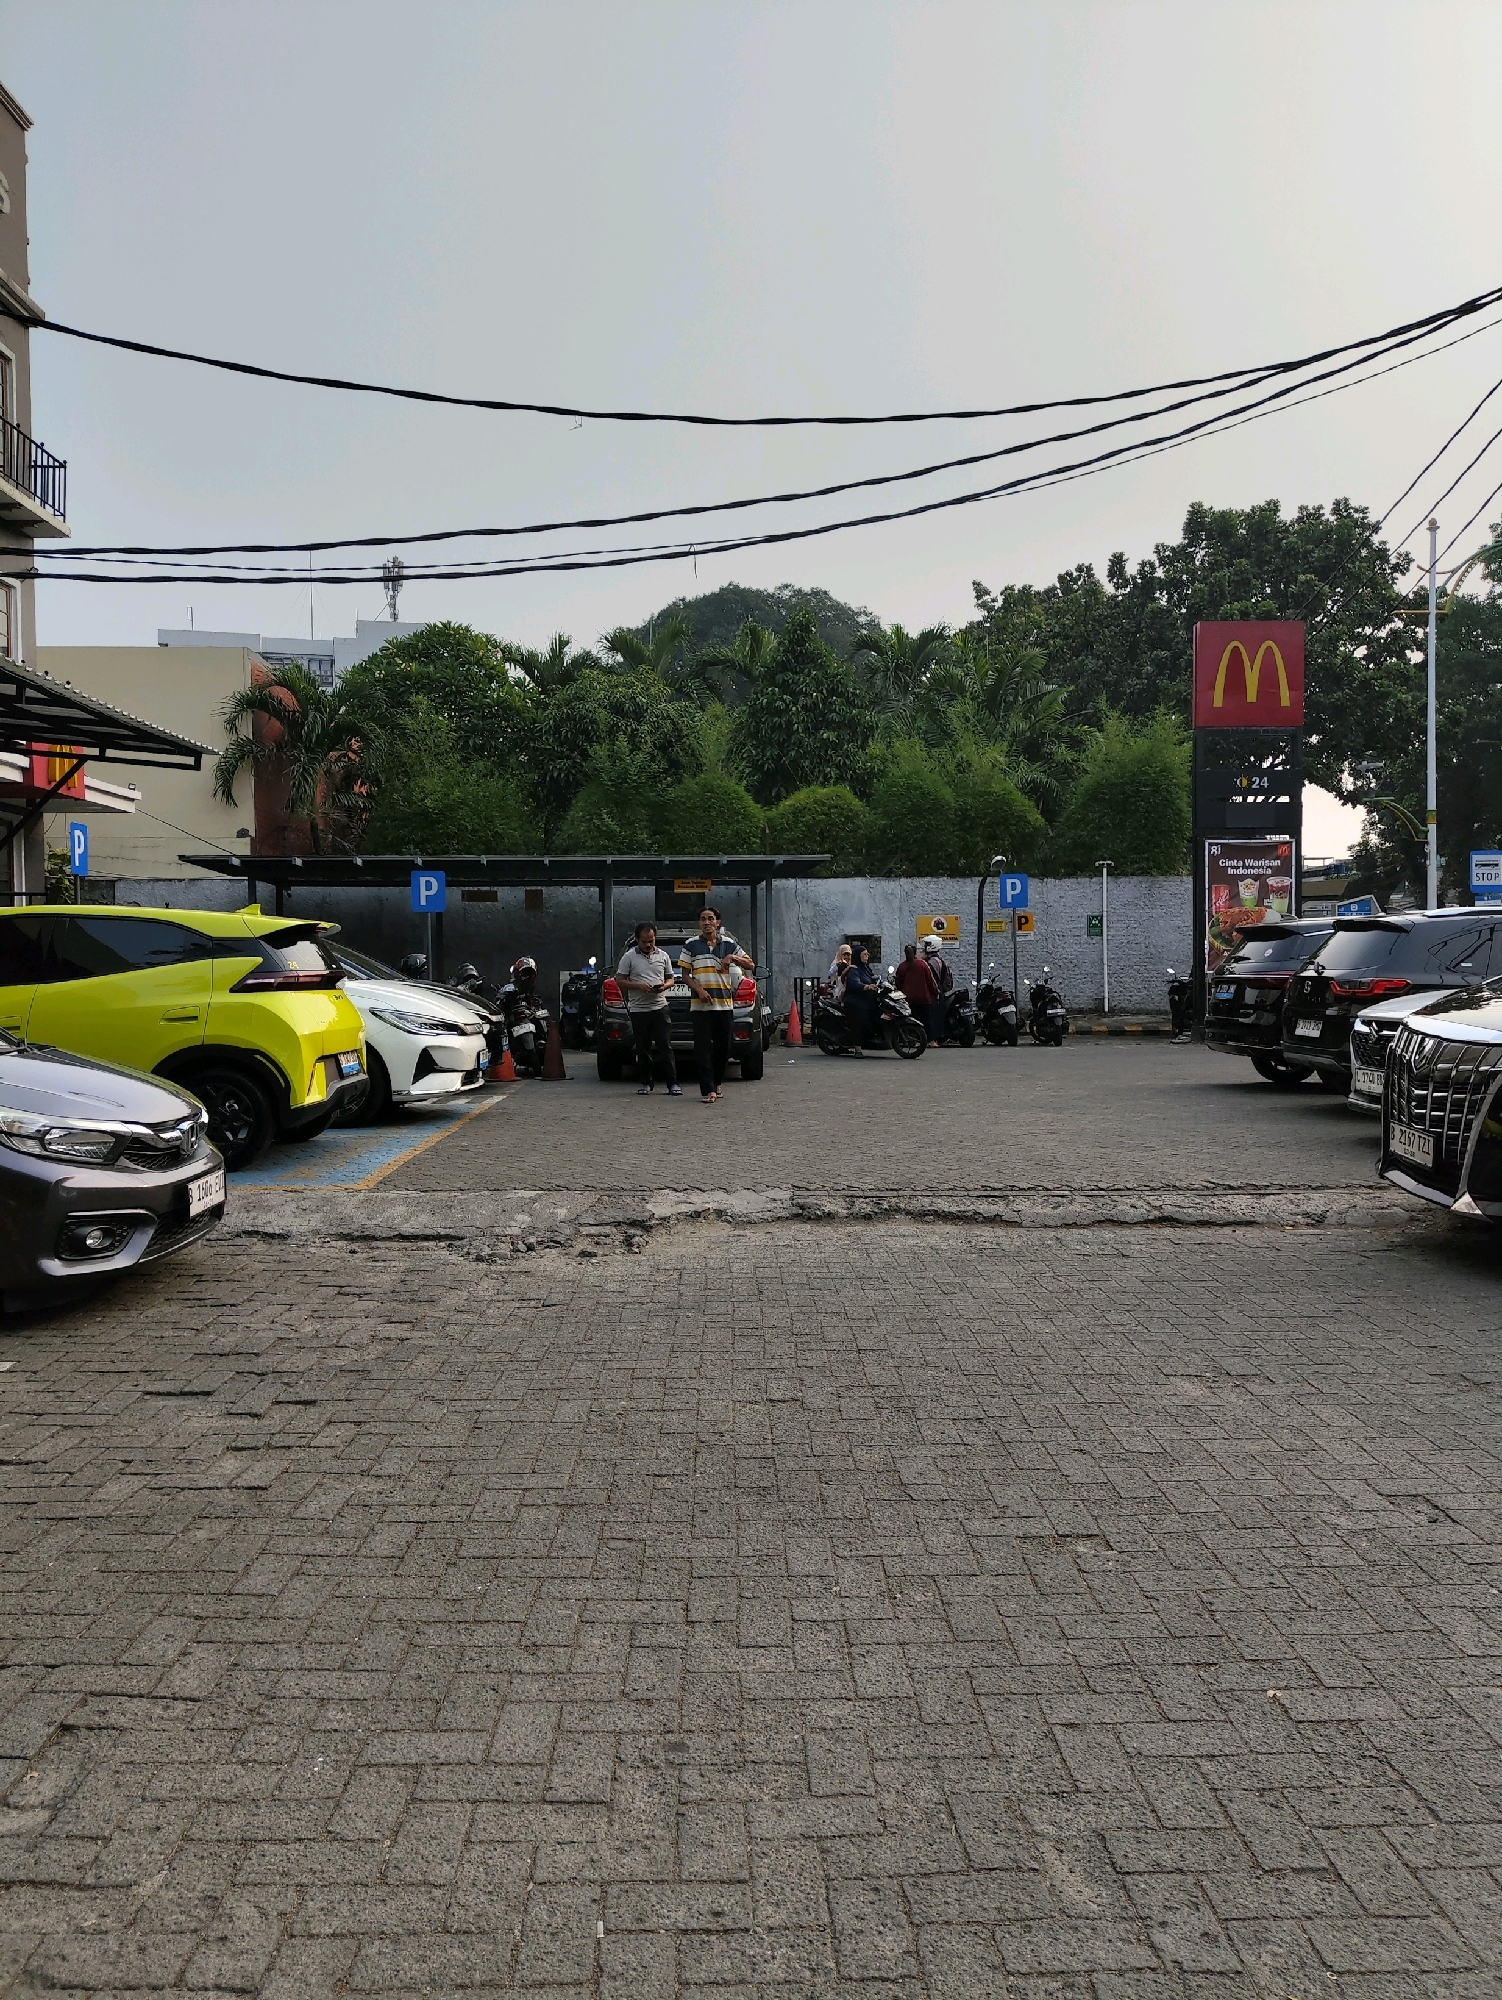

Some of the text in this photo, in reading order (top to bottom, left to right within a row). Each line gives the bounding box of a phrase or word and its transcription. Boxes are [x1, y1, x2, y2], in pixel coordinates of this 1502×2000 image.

[1251, 776, 1270, 789] 24
[73, 829, 85, 867] P
[1218, 858, 1281, 867] Cinta Warisan
[1227, 867, 1272, 875] Indonesia
[1475, 872, 1500, 882] STOP
[419, 876, 439, 906] P
[1006, 878, 1022, 903] P
[1017, 915, 1029, 931] P
[1390, 1125, 1396, 1141] B
